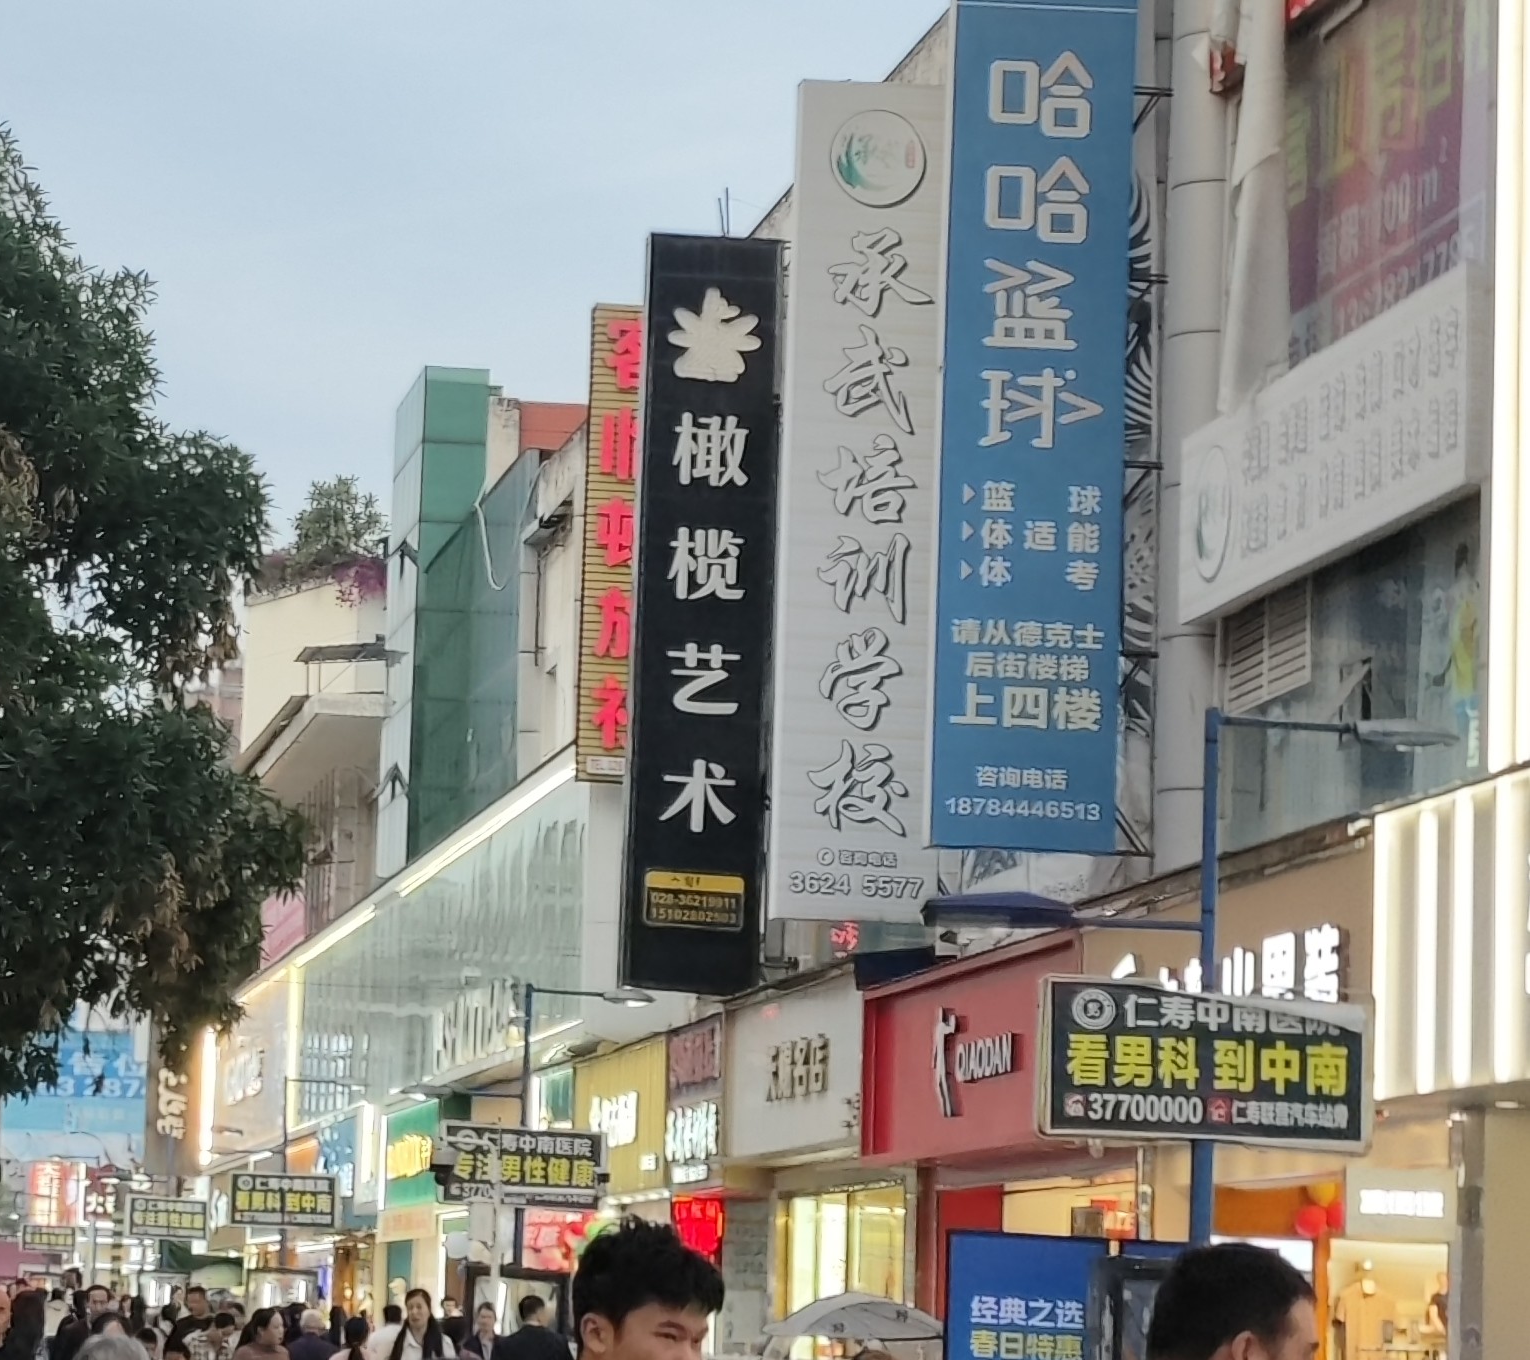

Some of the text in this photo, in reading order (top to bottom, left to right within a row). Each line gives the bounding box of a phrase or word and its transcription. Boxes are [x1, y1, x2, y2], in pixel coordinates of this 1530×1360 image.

[979, 49, 1104, 448] 哈哈篮球
[980, 518, 1101, 554] 体适能
[659, 411, 750, 833] 橄榄艺术
[951, 618, 1105, 651] 请从德克士
[966, 652, 1090, 683] 后街楼梯
[949, 682, 1102, 732] 上四楼
[975, 765, 1068, 792] 咨询电话
[945, 796, 1101, 822] 18784446513
[789, 872, 924, 900] 3624 5577
[956, 1031, 1012, 1082] QIAODAN
[1066, 1032, 1348, 1097] 看男科 到中南
[1087, 1093, 1203, 1124] 37700000
[970, 1295, 1085, 1329] 经典之选
